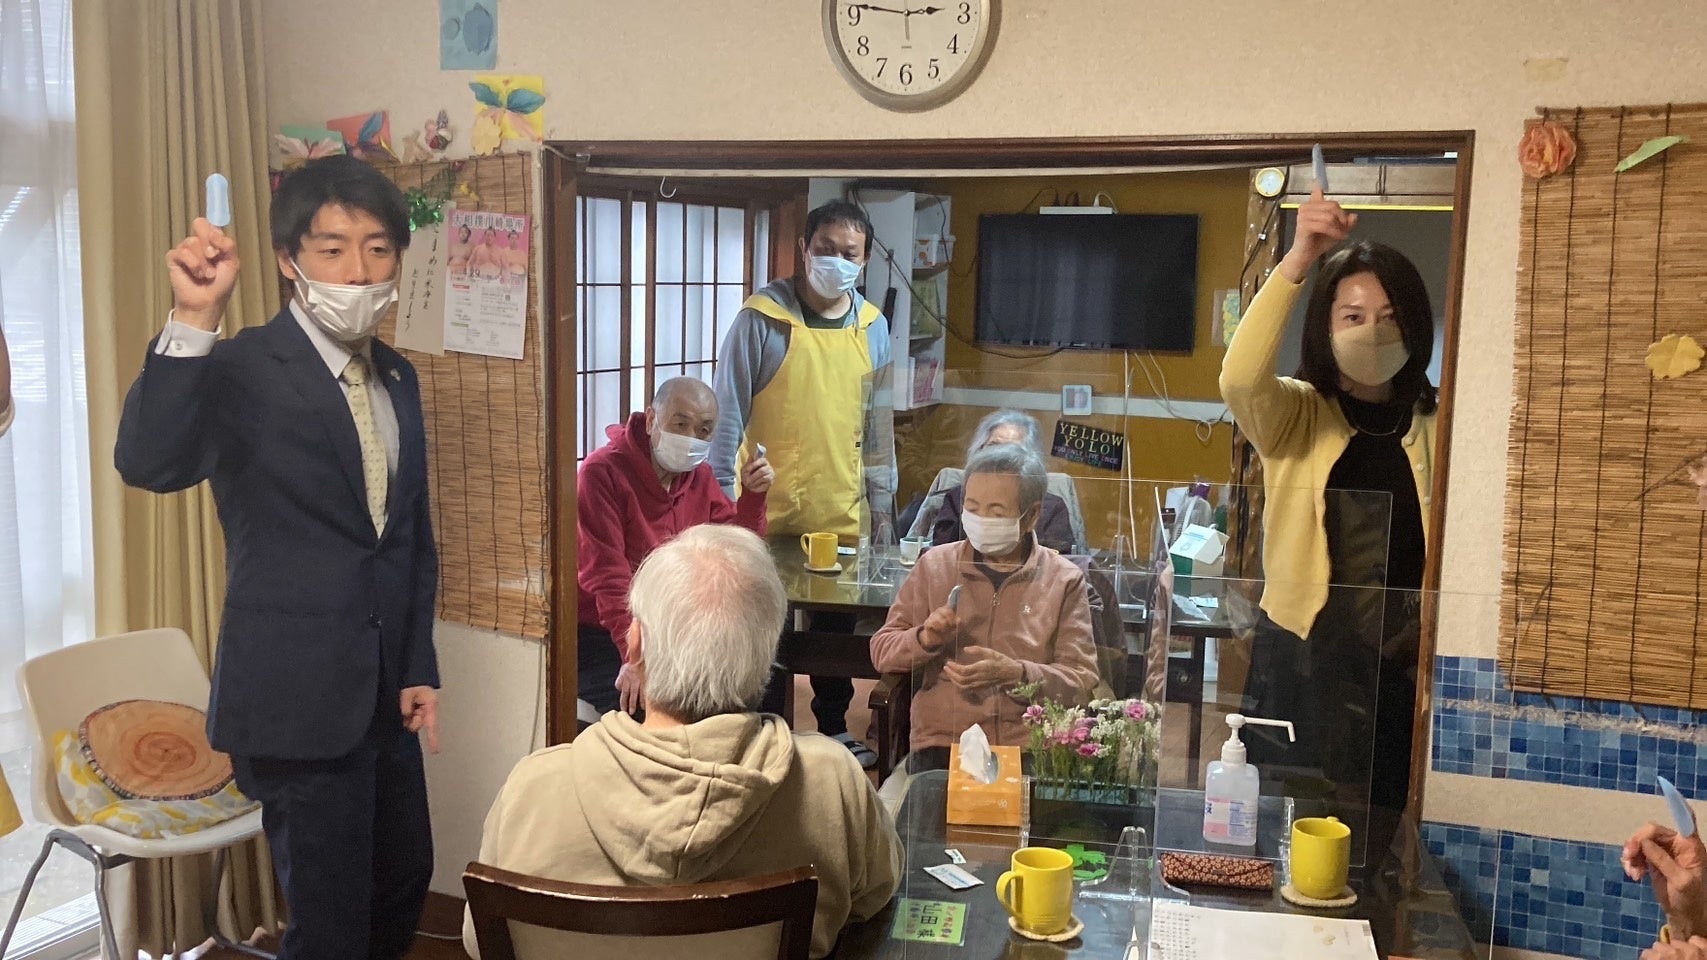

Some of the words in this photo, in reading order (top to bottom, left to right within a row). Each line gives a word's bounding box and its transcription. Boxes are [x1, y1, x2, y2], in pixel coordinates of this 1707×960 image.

[848, 5, 861, 26] 9
[957, 2, 970, 24] 3
[857, 35, 869, 56] 8
[947, 34, 959, 54] 4
[876, 57, 888, 78] 7
[899, 64, 912, 85] 6
[927, 58, 939, 79] 5
[1060, 422, 1124, 447] YELLOW
[1064, 435, 1110, 455] YOLO
